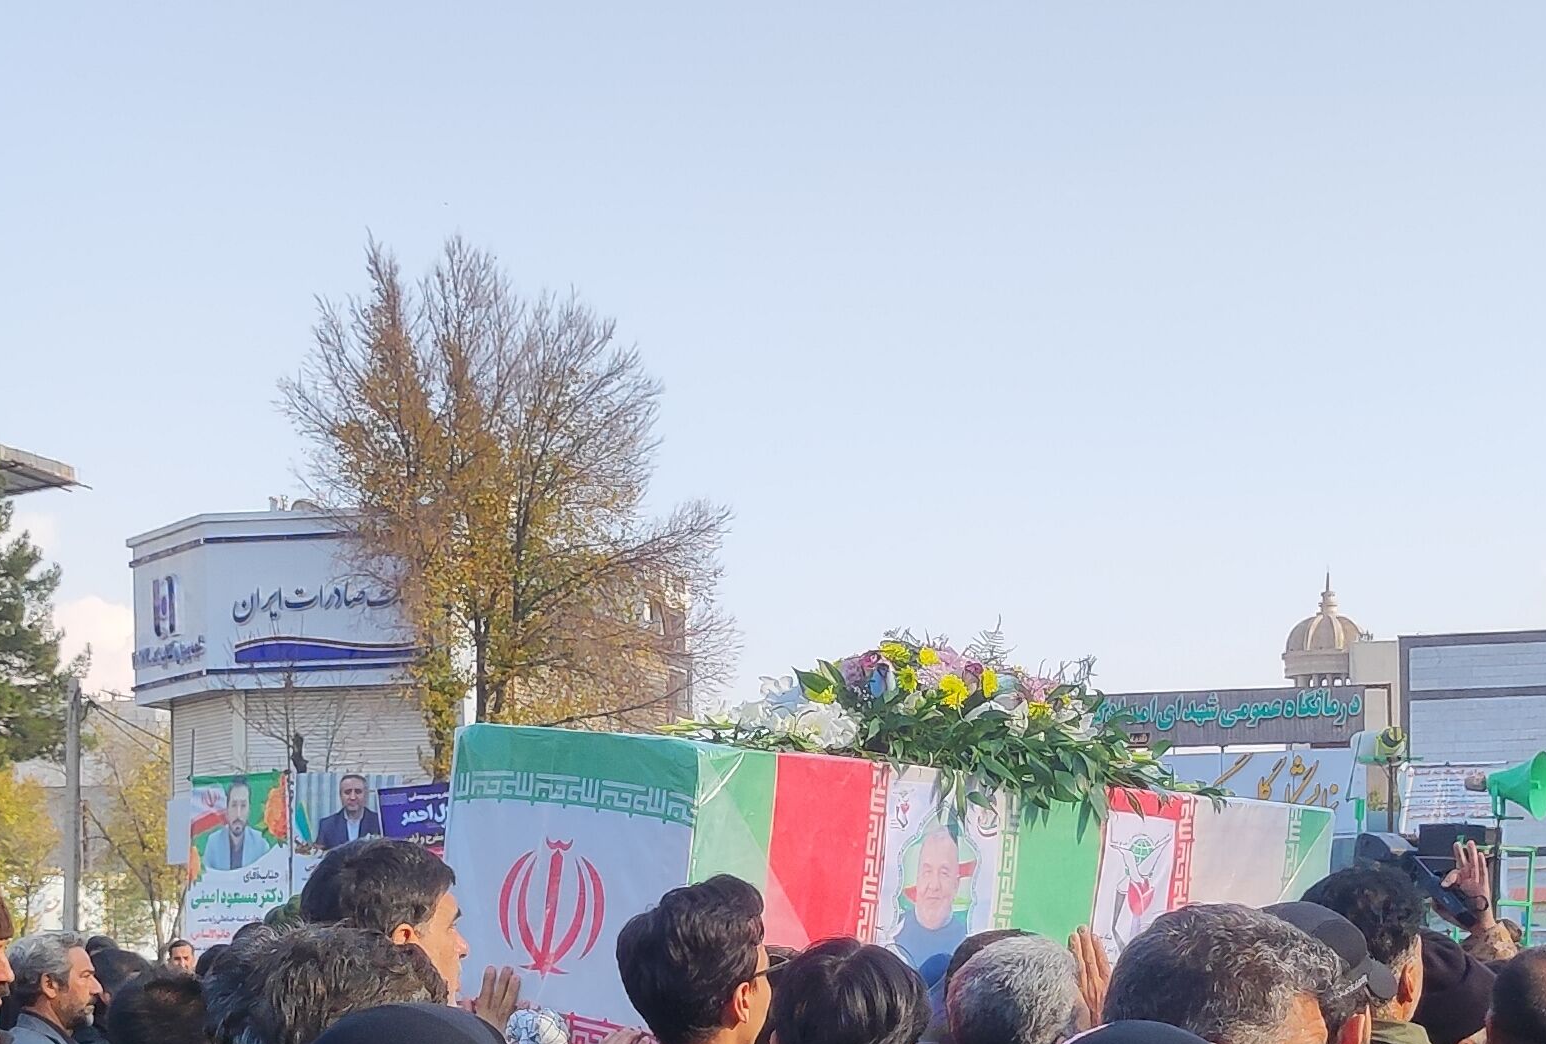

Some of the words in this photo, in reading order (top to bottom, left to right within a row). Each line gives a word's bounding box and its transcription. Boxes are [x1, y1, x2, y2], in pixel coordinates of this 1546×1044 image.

[232, 586, 282, 623] ایران
[284, 581, 365, 610] صادرات
[1155, 691, 1219, 731] شهدای
[1218, 697, 1282, 728] عمومی
[1284, 687, 1362, 726] درمانگاه
[243, 867, 263, 883] آقای
[262, 868, 280, 883] جناب
[191, 888, 220, 909] امینی
[220, 890, 258, 908] مسعود
[258, 887, 284, 908] دکتر
